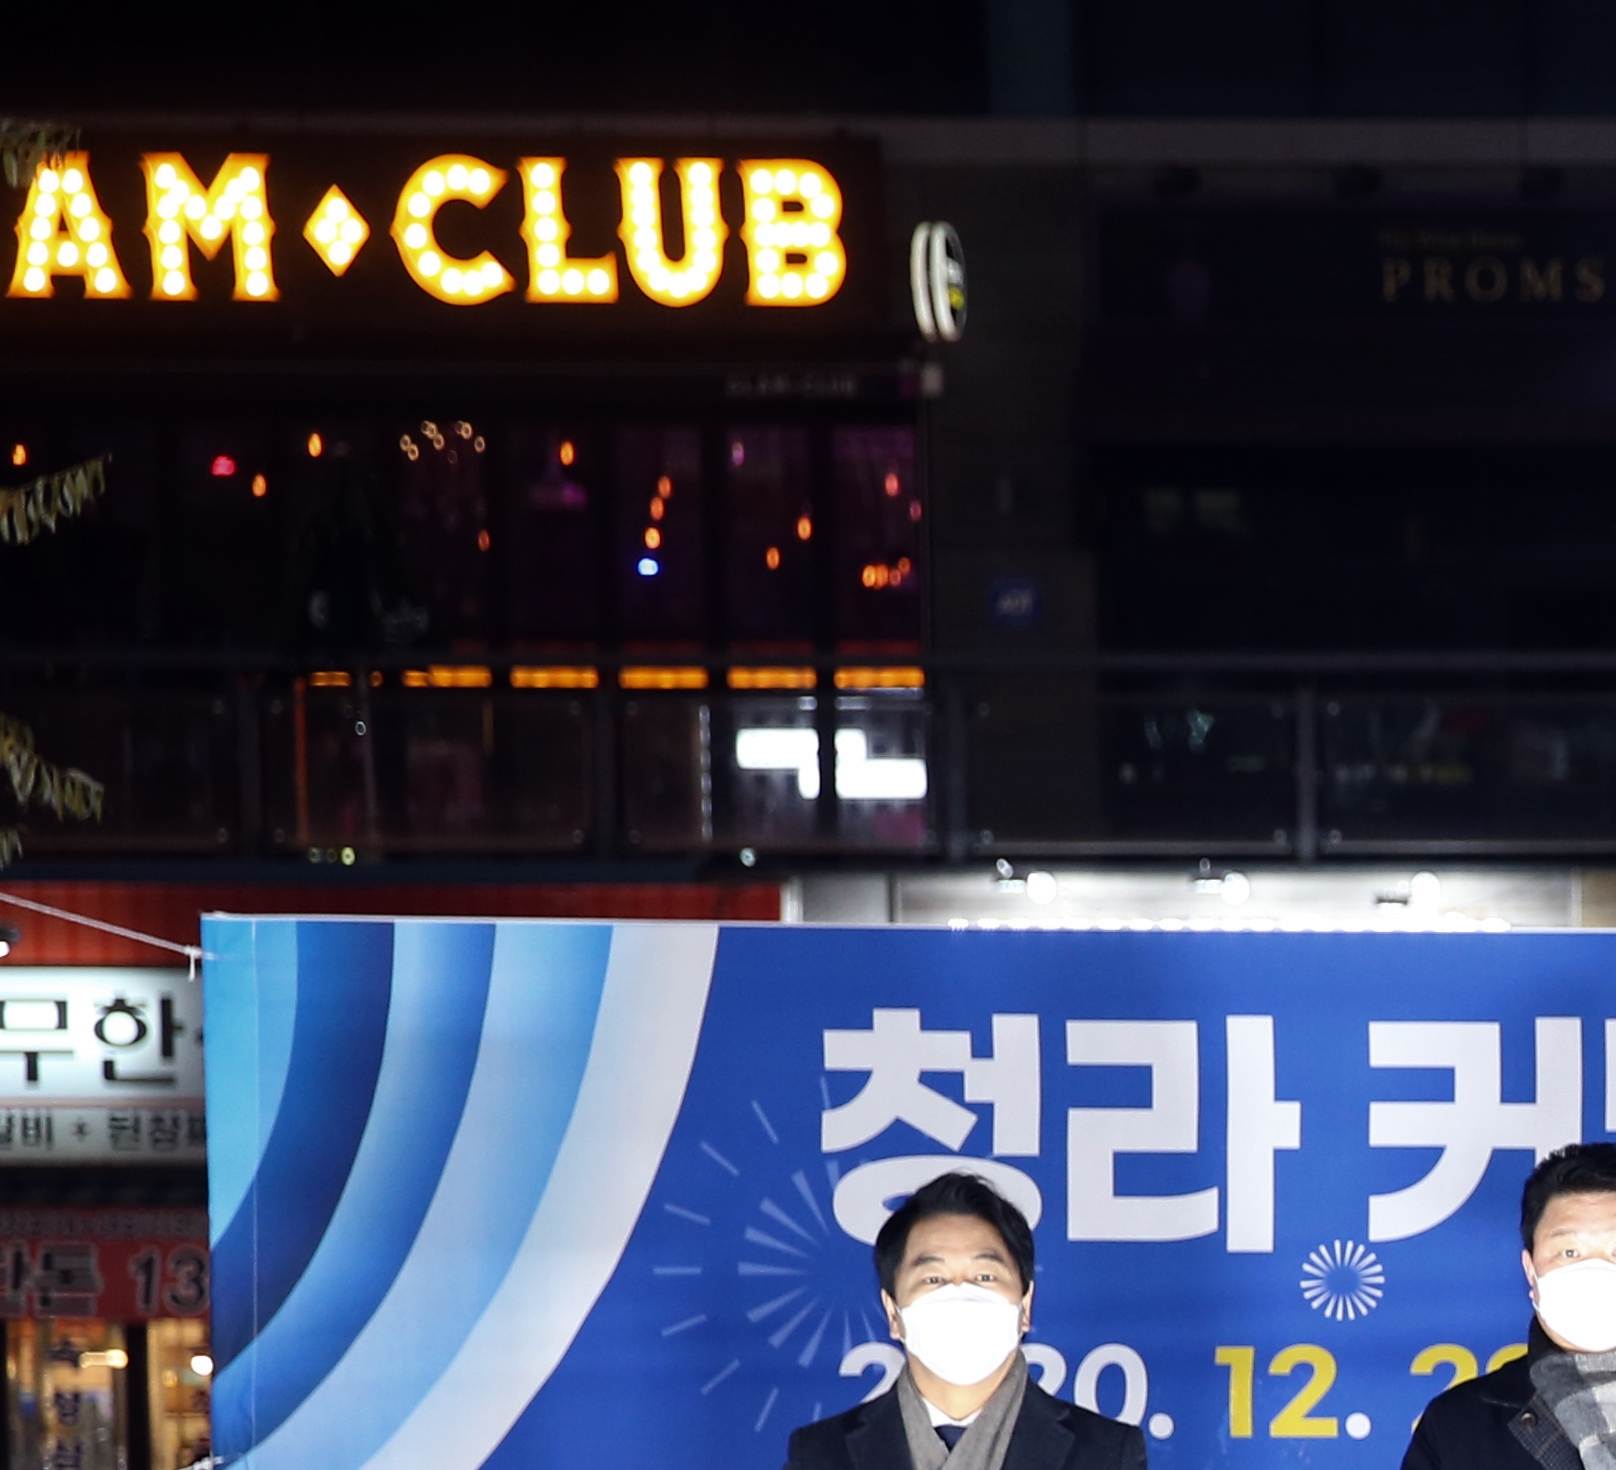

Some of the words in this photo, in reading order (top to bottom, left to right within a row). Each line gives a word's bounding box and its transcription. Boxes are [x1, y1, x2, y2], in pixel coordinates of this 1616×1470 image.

[390, 152, 847, 307] CLUB
[1381, 256, 1606, 304] PROMS
[0, 994, 184, 1086] 무한
[821, 1008, 1300, 1253] 청라
[1214, 1344, 1371, 1439] 12.
